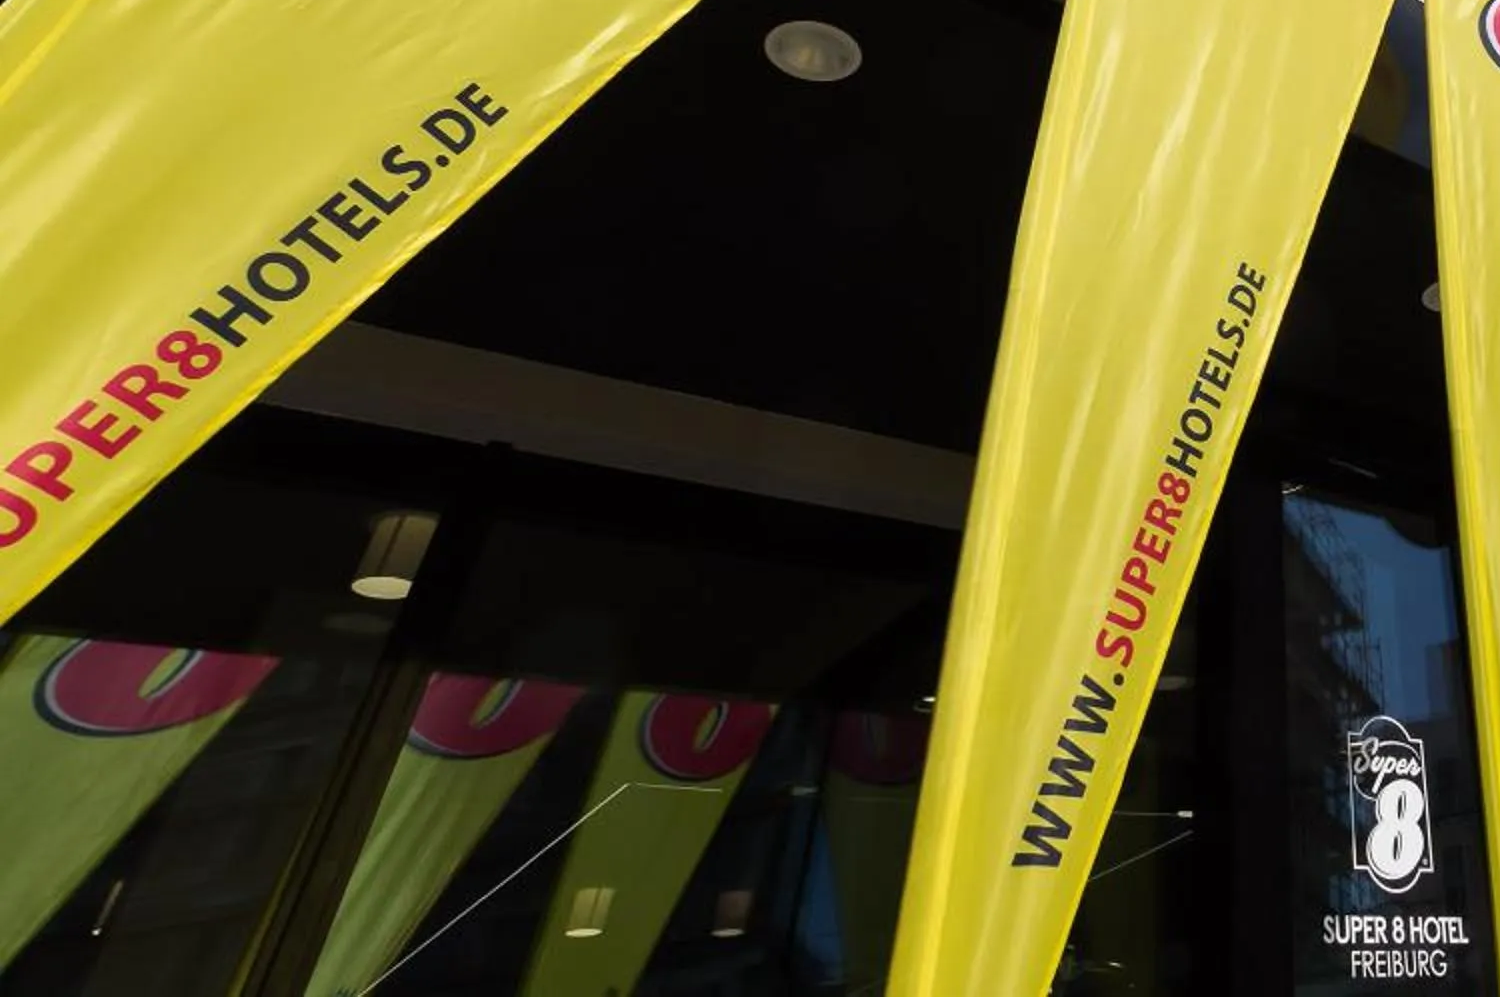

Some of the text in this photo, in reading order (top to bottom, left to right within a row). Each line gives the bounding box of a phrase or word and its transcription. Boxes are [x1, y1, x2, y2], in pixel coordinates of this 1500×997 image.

[1011, 261, 1267, 869] WWW.SUPER8HOTELS.DE
[1353, 736, 1422, 795] Super
[1366, 779, 1425, 880] 8
[1323, 915, 1469, 945] SUPER 8 HOTEL
[1351, 949, 1447, 978] FREIBURG
